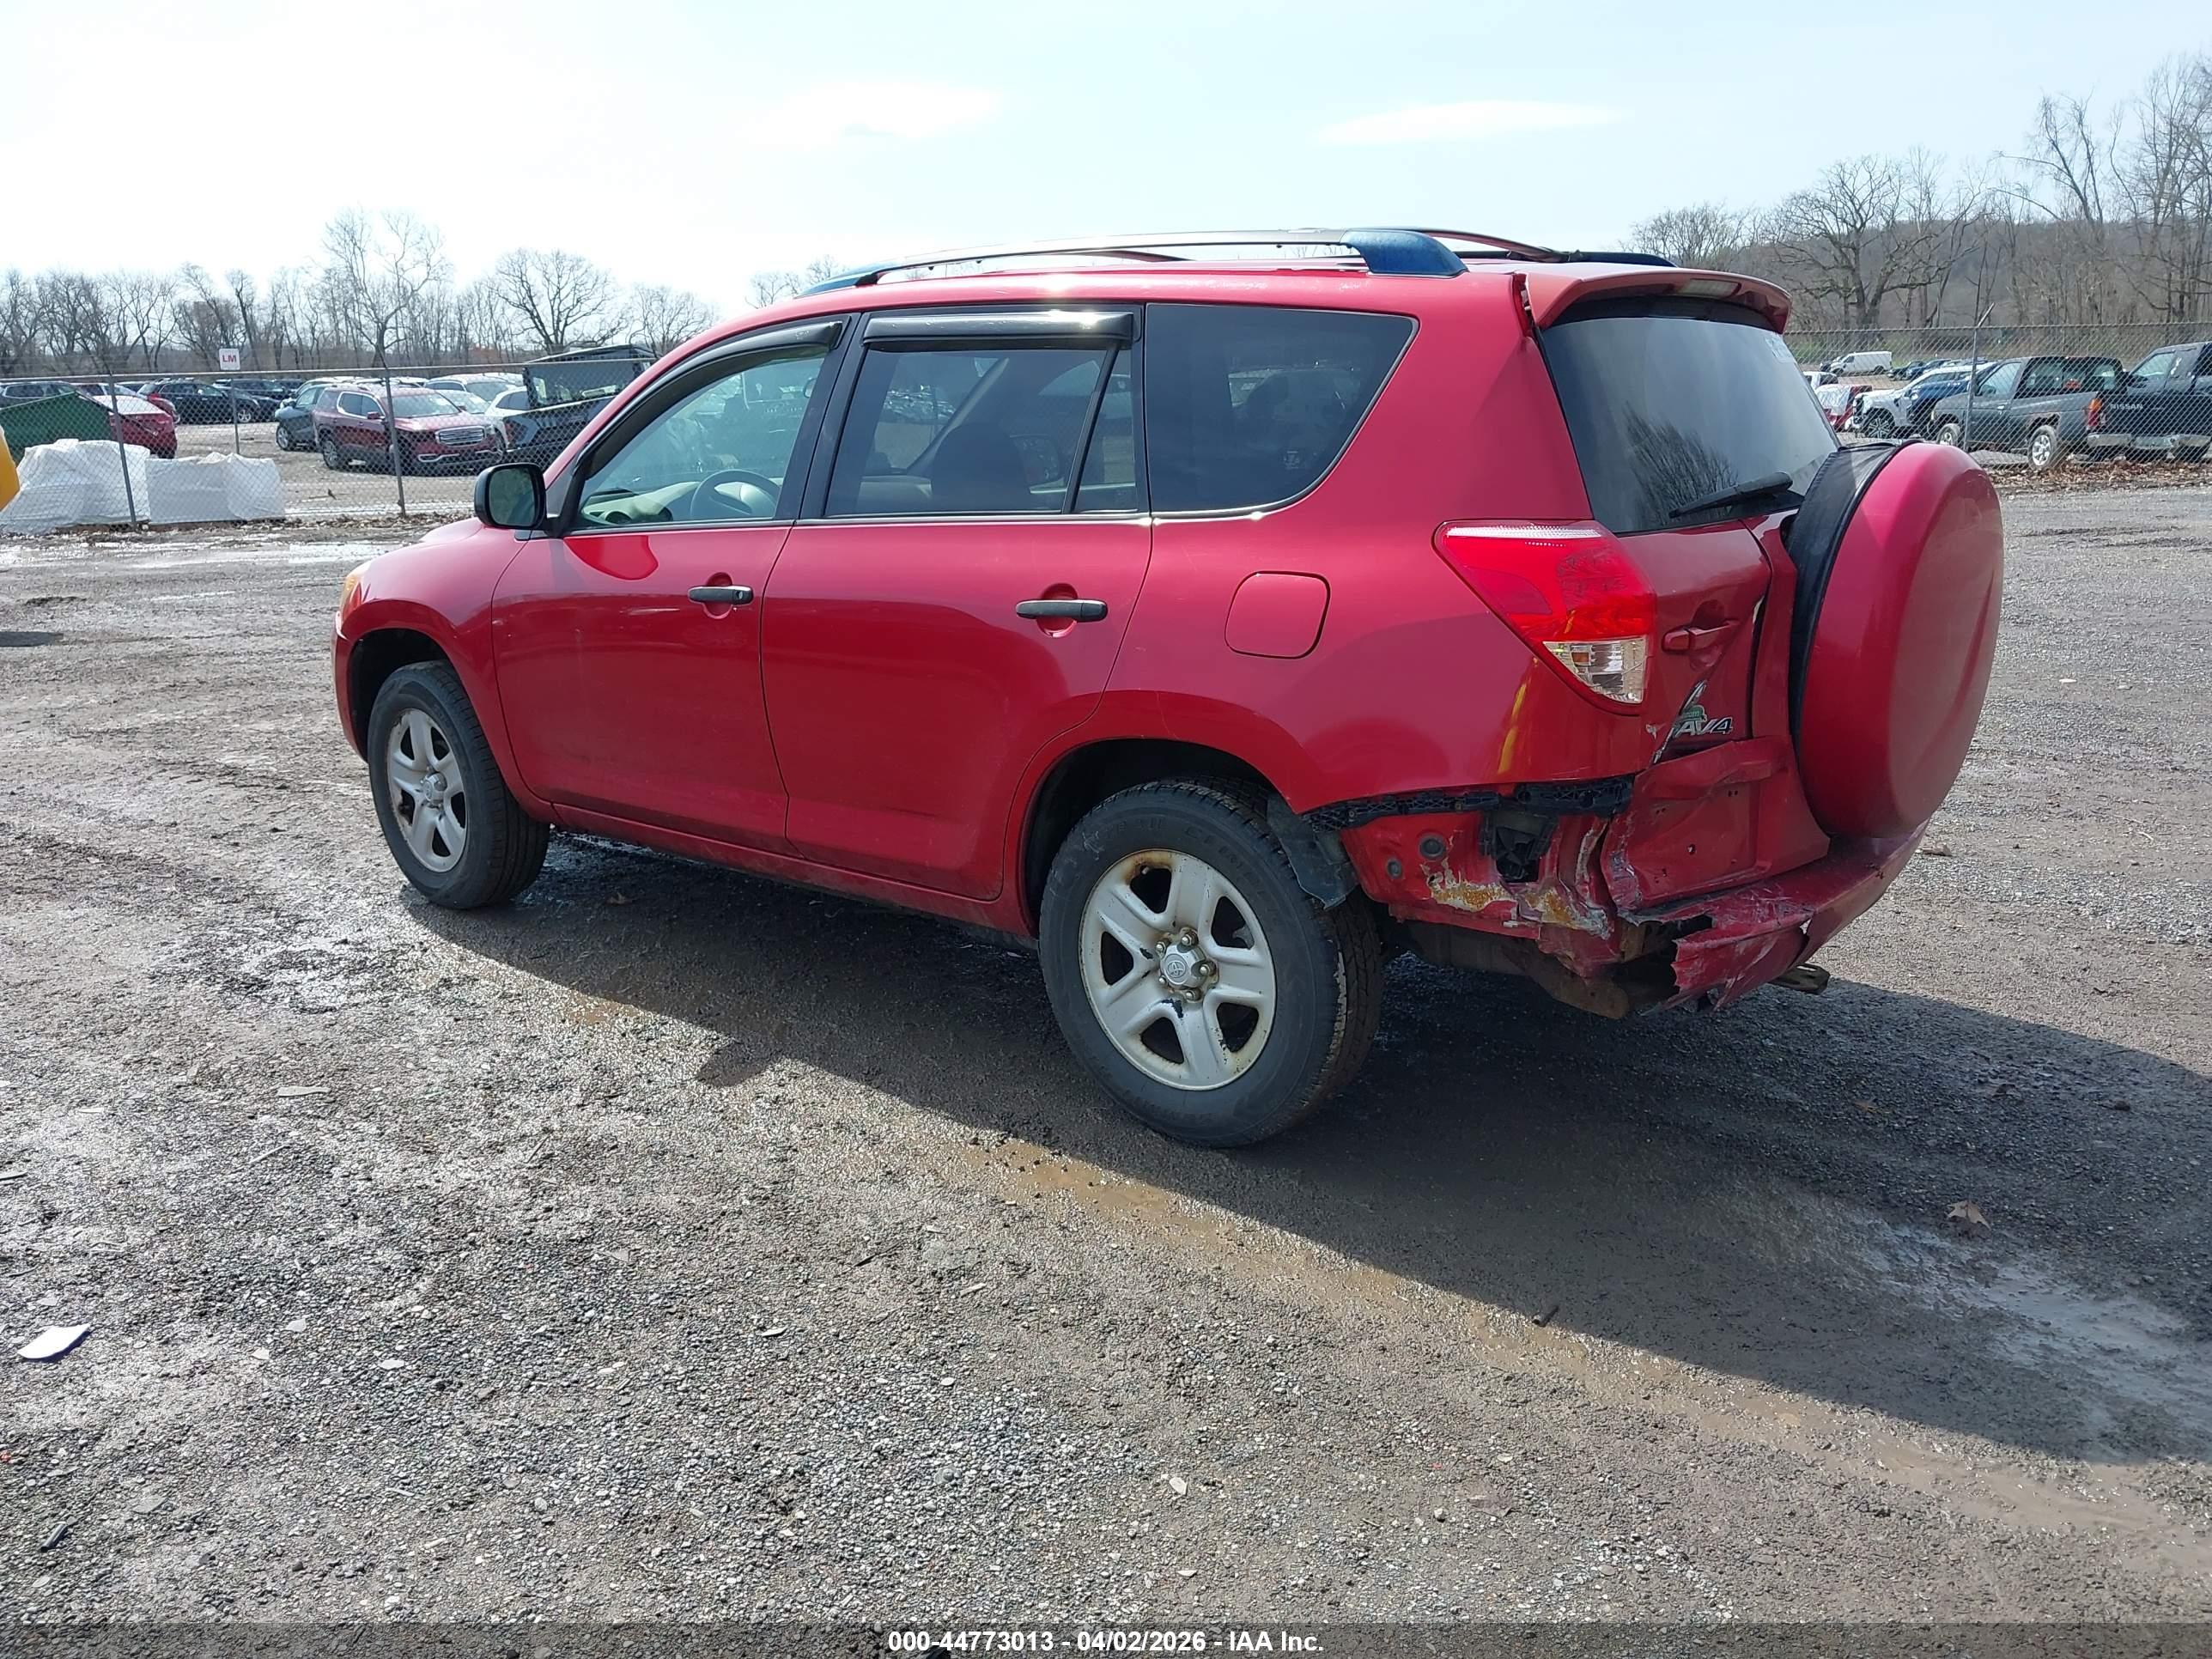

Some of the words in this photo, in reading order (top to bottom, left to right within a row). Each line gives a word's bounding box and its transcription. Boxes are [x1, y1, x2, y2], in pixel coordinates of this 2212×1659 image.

[222, 354, 237, 363] LM
[2109, 403, 2144, 411] NISSAN
[1671, 716, 1734, 738] AV4
